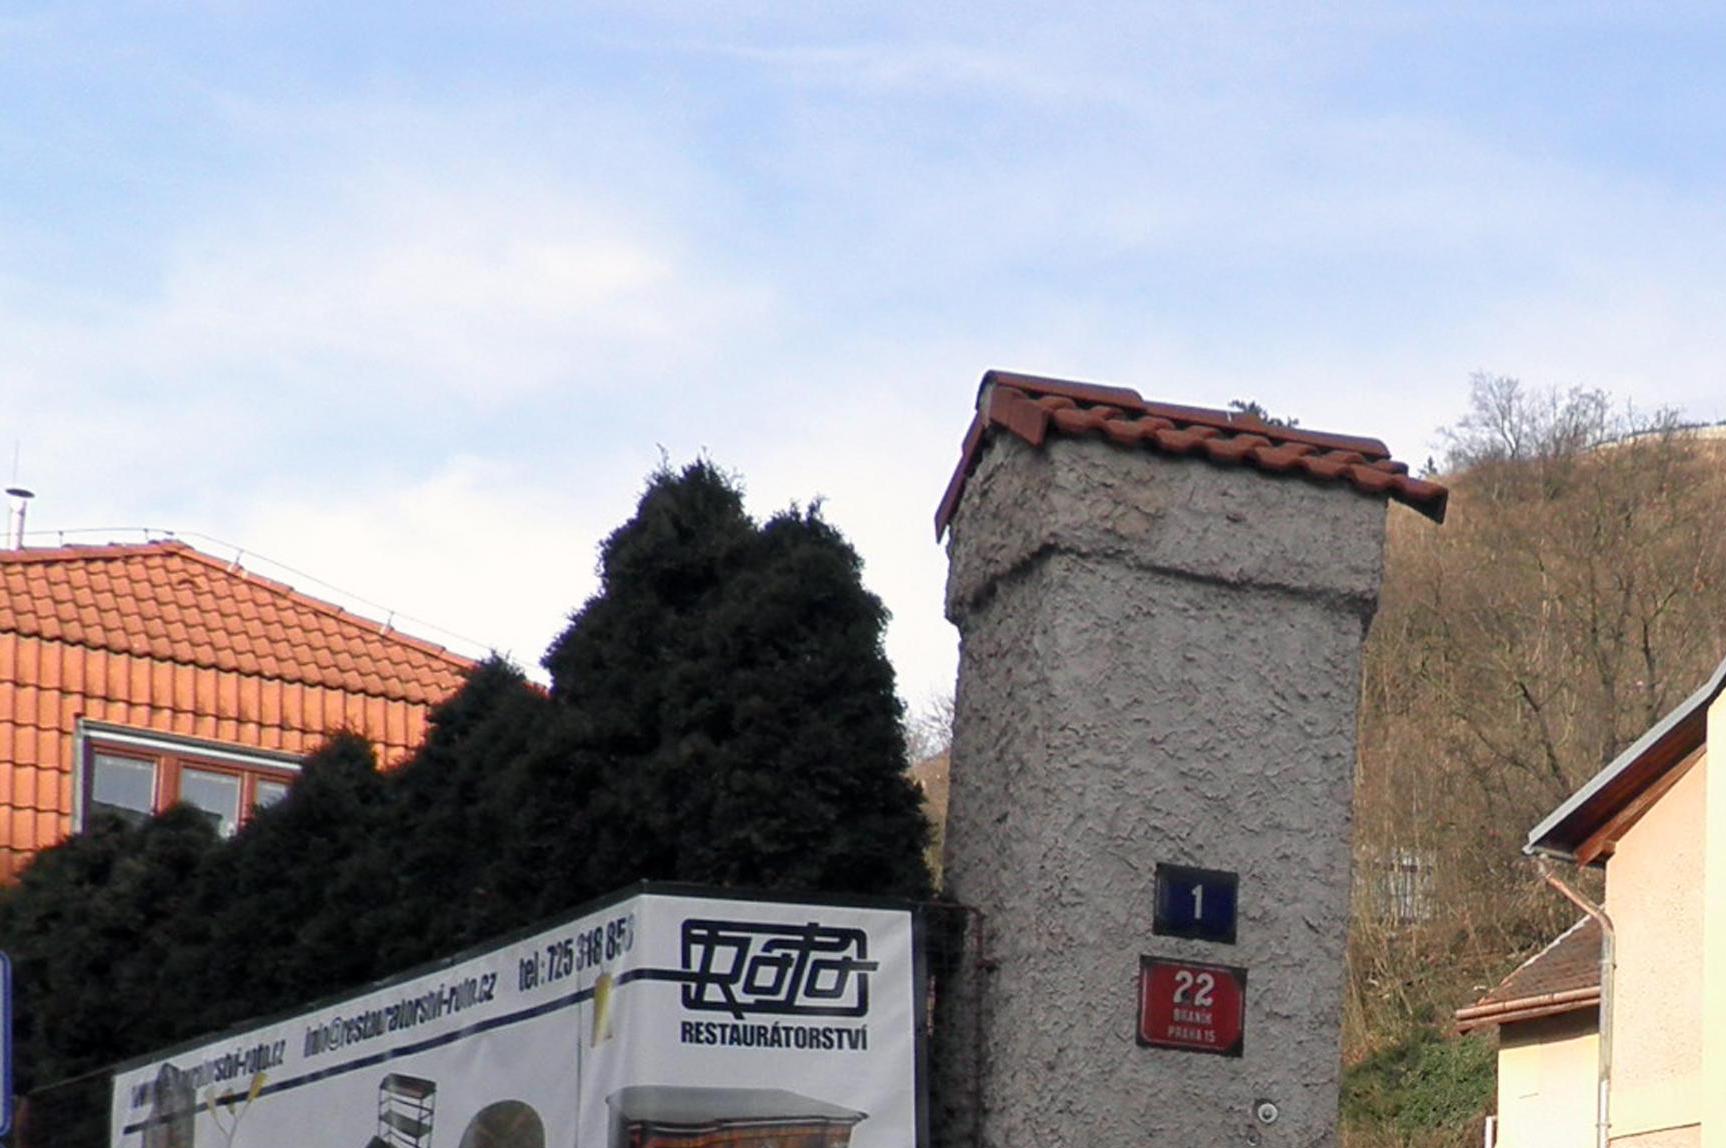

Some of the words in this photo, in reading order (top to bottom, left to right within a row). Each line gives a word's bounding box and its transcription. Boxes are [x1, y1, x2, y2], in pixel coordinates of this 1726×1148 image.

[1191, 884, 1203, 920] 1
[547, 938, 575, 982] 725
[1173, 970, 1215, 1007] 22
[680, 1020, 868, 1051] RESTAURÁTORSTVÍ
